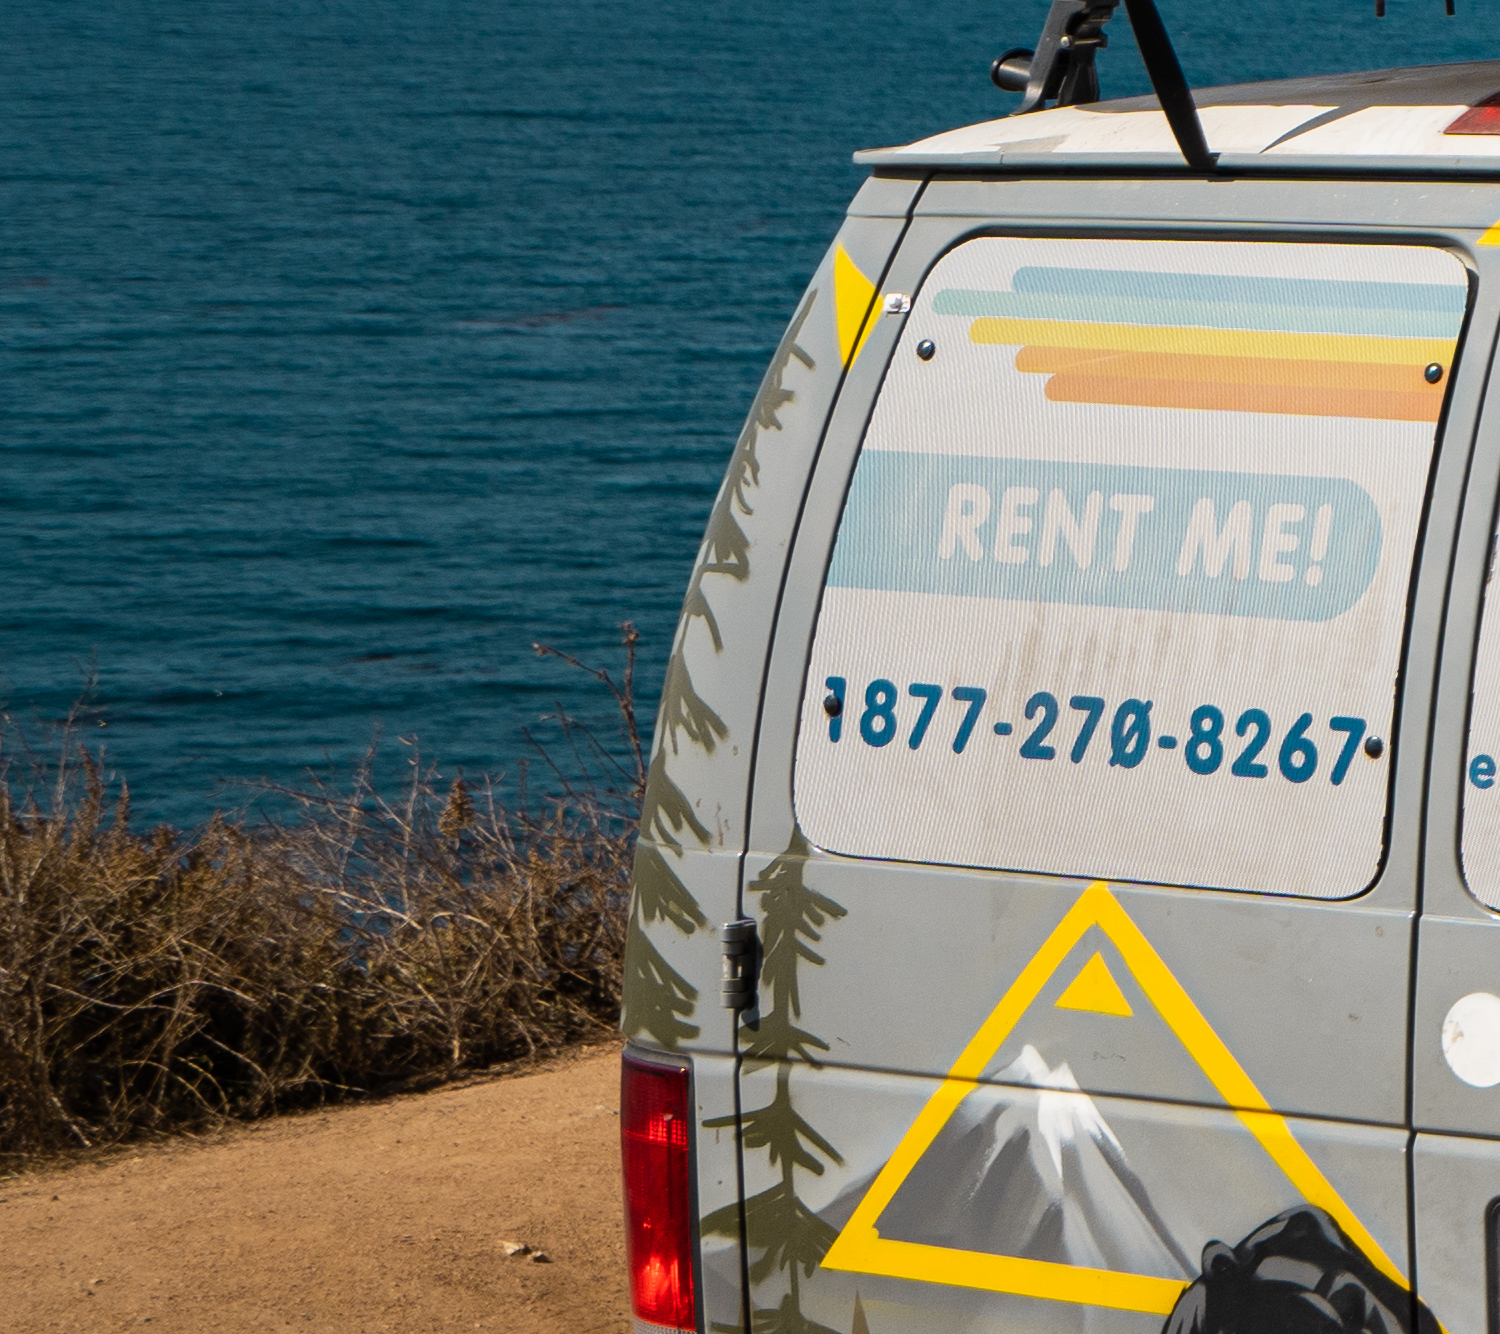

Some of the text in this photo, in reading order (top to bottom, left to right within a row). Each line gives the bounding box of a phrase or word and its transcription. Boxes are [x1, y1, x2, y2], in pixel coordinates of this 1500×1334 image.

[938, 483, 1333, 587] RENT ME!
[825, 676, 1367, 786] 1877-270-8267
